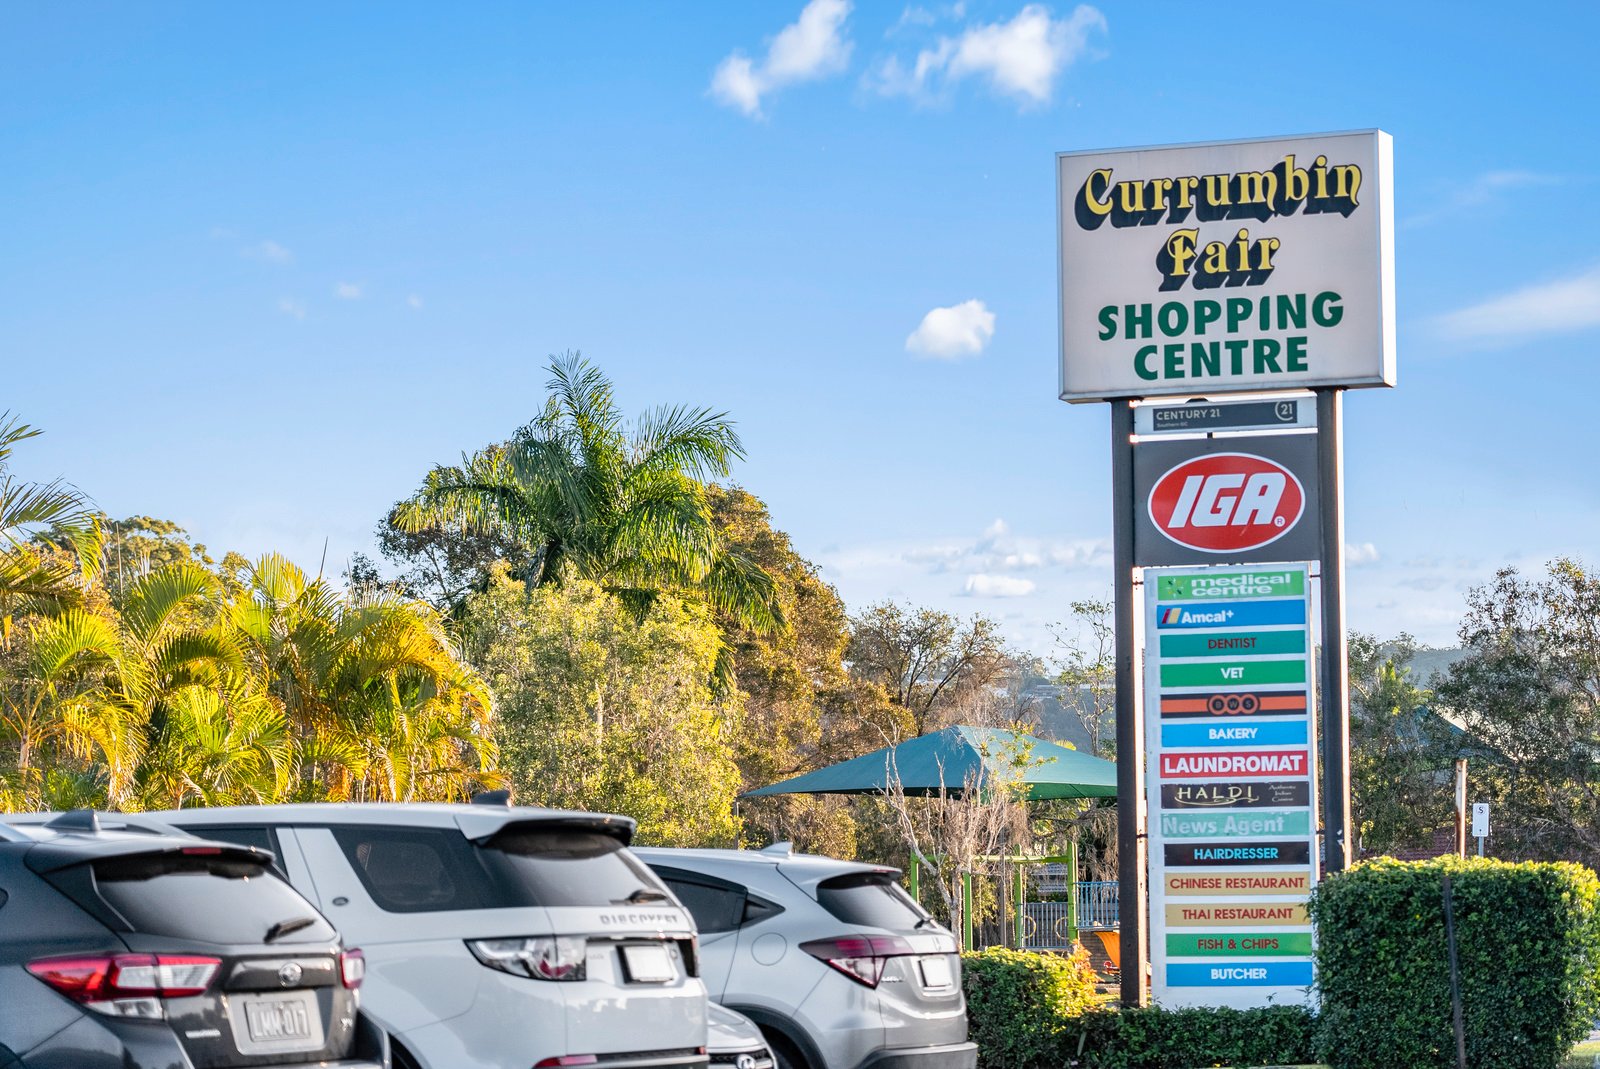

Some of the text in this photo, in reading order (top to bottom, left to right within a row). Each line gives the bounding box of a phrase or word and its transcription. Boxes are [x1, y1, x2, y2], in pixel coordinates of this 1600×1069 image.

[1074, 154, 1362, 231] Currumbin
[1156, 228, 1280, 292] Fair
[1098, 291, 1344, 341] SHOPPING
[1134, 336, 1308, 380] CENTRE
[1156, 408, 1220, 421] CENTURY 21
[1280, 403, 1293, 415] 21
[1167, 472, 1286, 529] IGA
[1191, 573, 1291, 588] medical
[1191, 584, 1273, 597] centre
[1207, 637, 1257, 650] DENTIST
[1220, 667, 1244, 679] VET
[1208, 728, 1258, 740] BAKERY
[1164, 754, 1303, 774] LAUNDROMAT
[1176, 786, 1254, 801] HALDI
[1163, 816, 1285, 836] News Agent
[1194, 847, 1279, 860] HAIRDRESSER
[1170, 877, 1305, 889] CHINESE RESTAURANT
[1182, 908, 1293, 920] THAI RESTAURANT
[1197, 938, 1279, 950] FISH & CHIPS
[1211, 968, 1267, 980] BUTCHER
